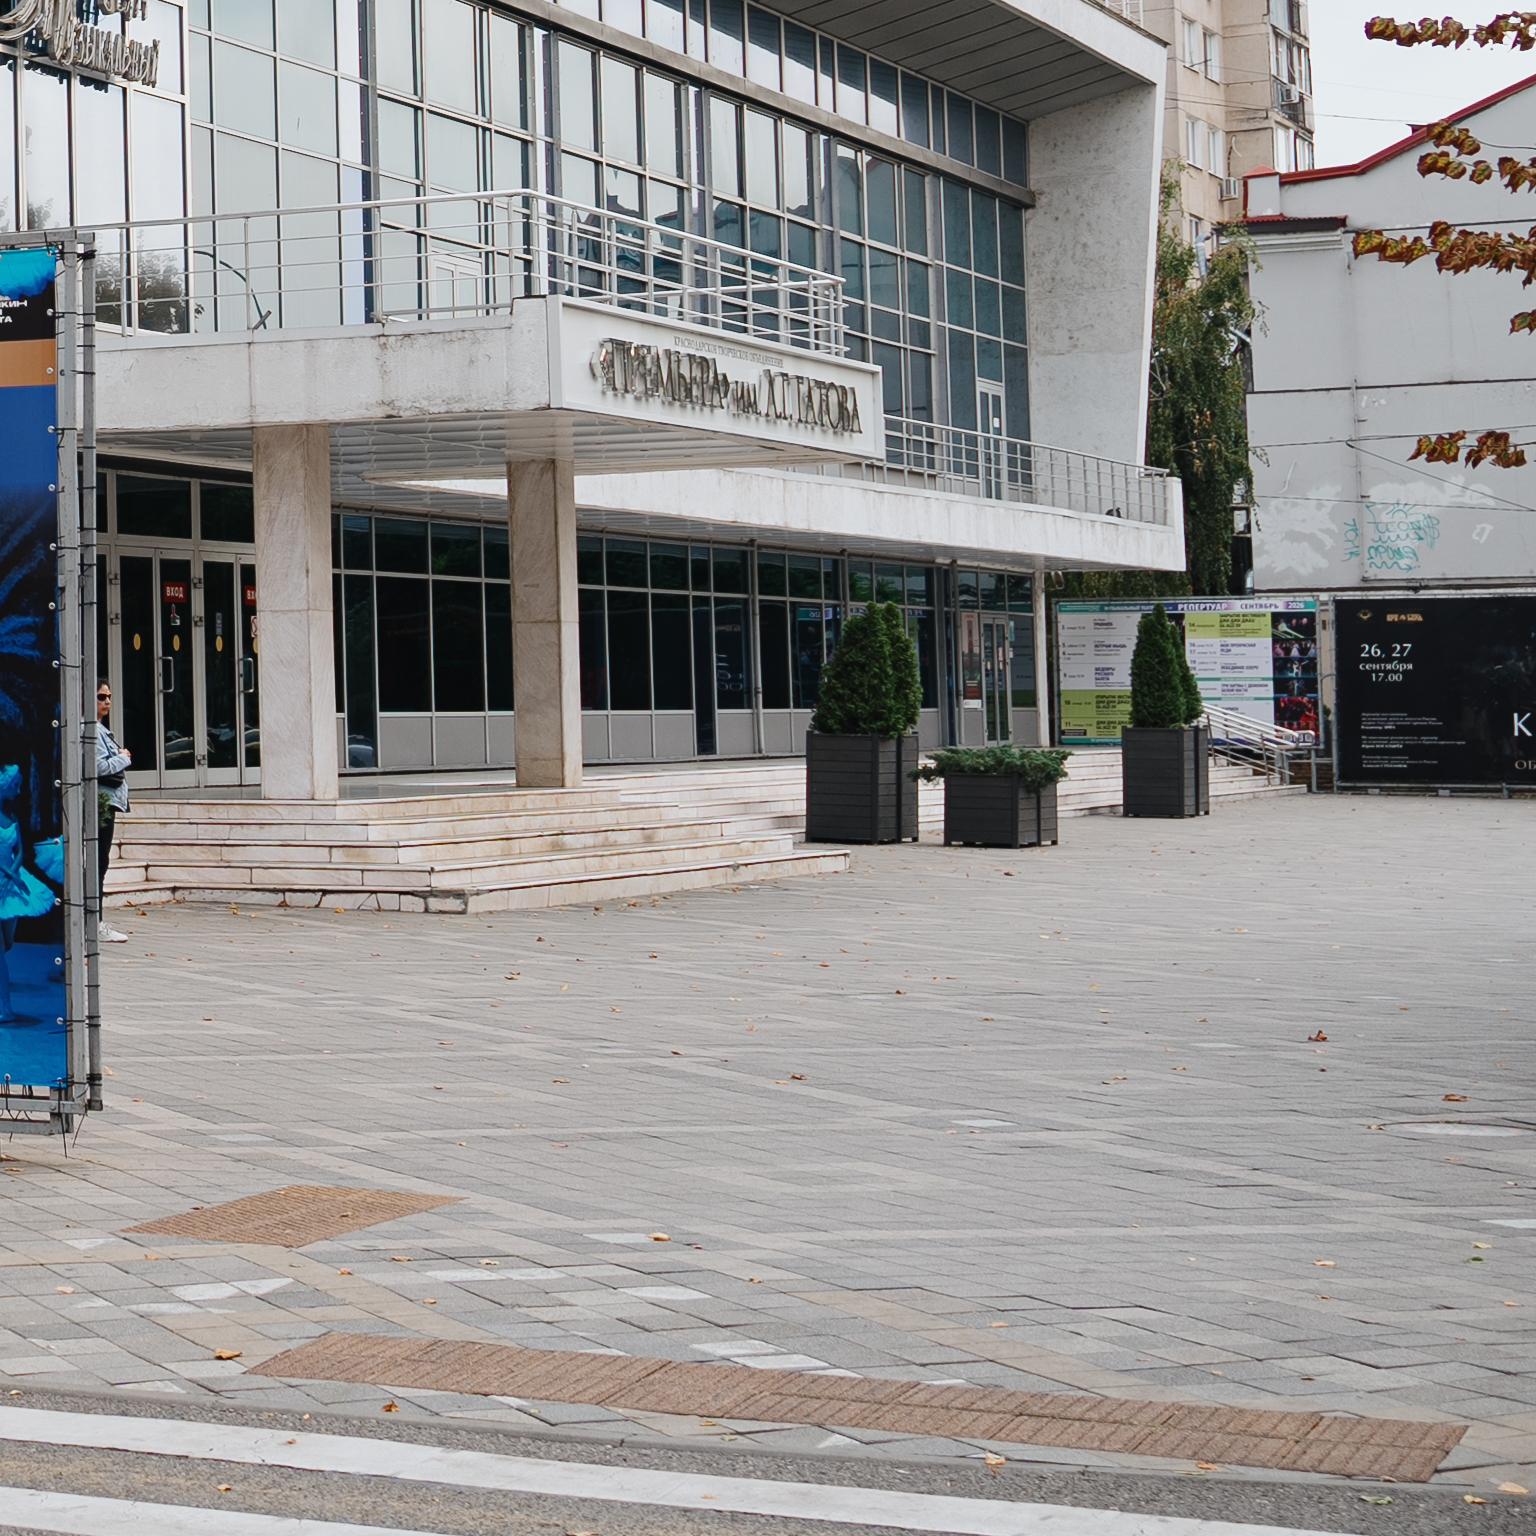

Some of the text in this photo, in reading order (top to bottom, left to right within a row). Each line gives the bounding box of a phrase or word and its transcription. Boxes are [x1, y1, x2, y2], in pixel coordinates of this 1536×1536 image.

[166, 586, 184, 599] ВХОД
[247, 589, 257, 600] ВХ
[1177, 602, 1228, 612] РЕПЕРТУАР
[1240, 602, 1280, 610] СЕНТЯБРЬ
[1360, 643, 1413, 658] 26, 27
[1359, 660, 1414, 671] сентября
[1371, 673, 1403, 682] 17.00
